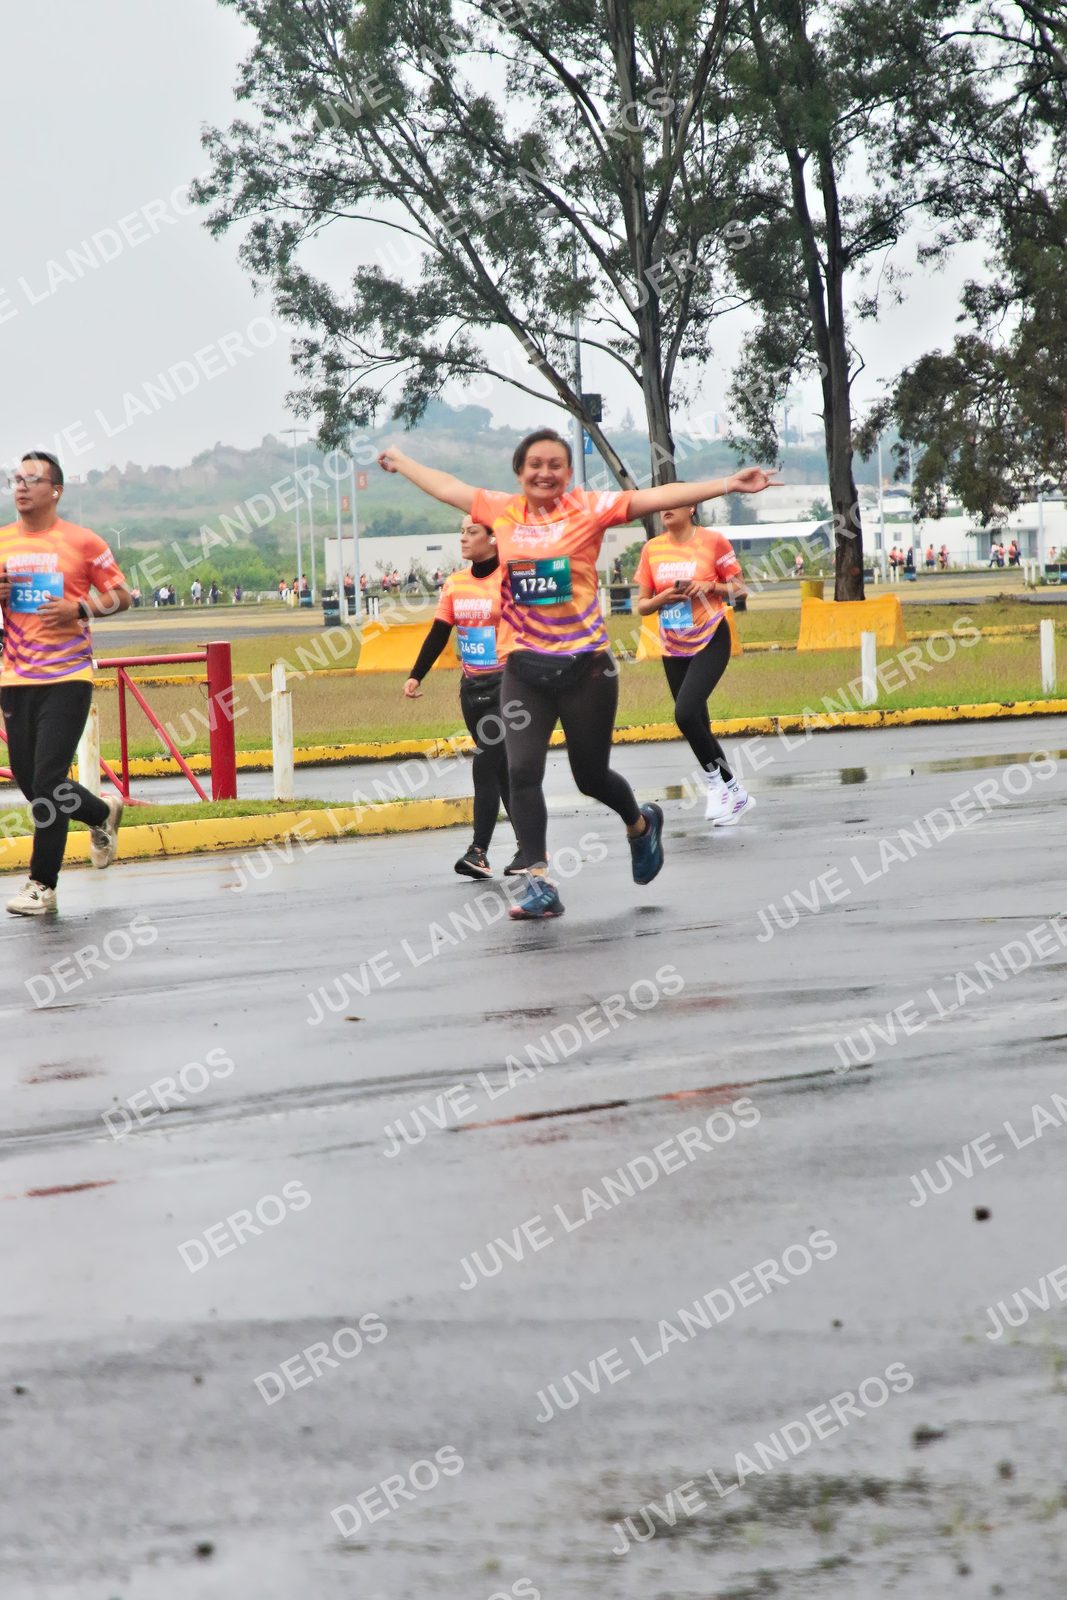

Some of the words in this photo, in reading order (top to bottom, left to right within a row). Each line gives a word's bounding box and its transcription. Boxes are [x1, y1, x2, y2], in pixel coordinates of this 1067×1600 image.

[584, 436, 590, 450] 7
[552, 560, 566, 570] 10K
[519, 576, 558, 592] 1724
